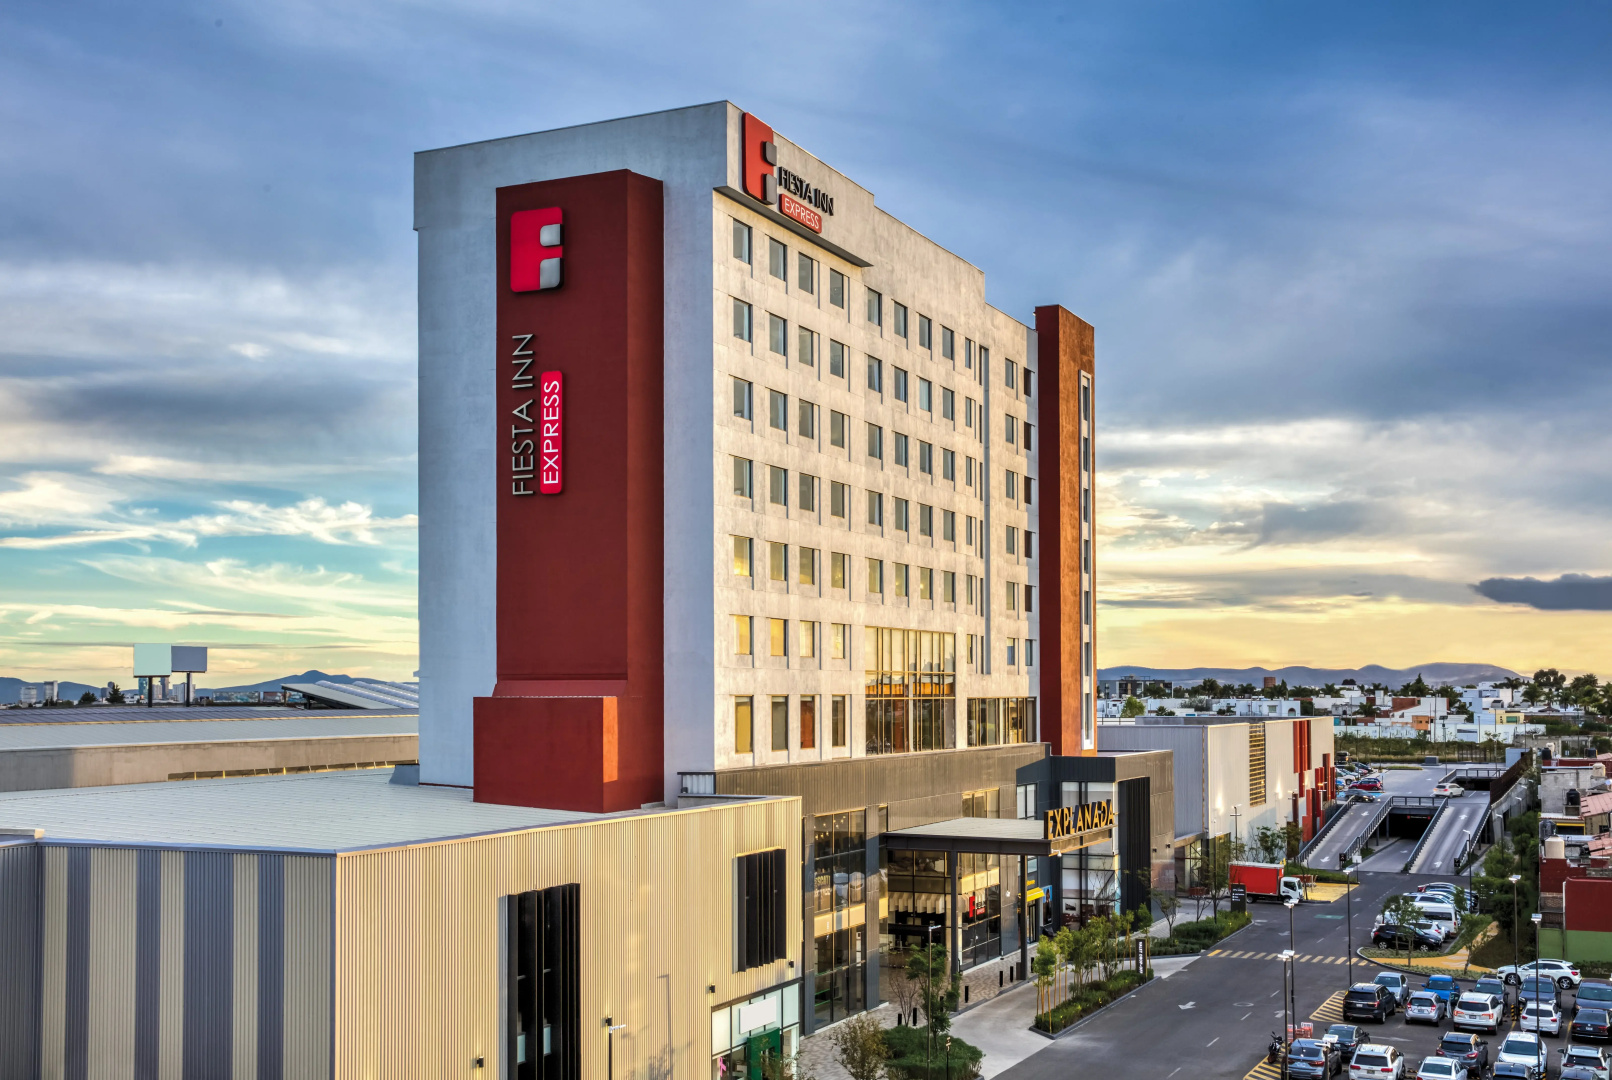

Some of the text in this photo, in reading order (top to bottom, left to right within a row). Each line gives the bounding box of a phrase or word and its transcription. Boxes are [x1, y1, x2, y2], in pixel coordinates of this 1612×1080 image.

[778, 166, 834, 216] FIESTA INN
[784, 197, 820, 229] EXPRESS
[512, 334, 534, 495] FIESTA INN
[543, 380, 560, 484] EXPRESS
[1047, 800, 1115, 840] EXPLANADA
